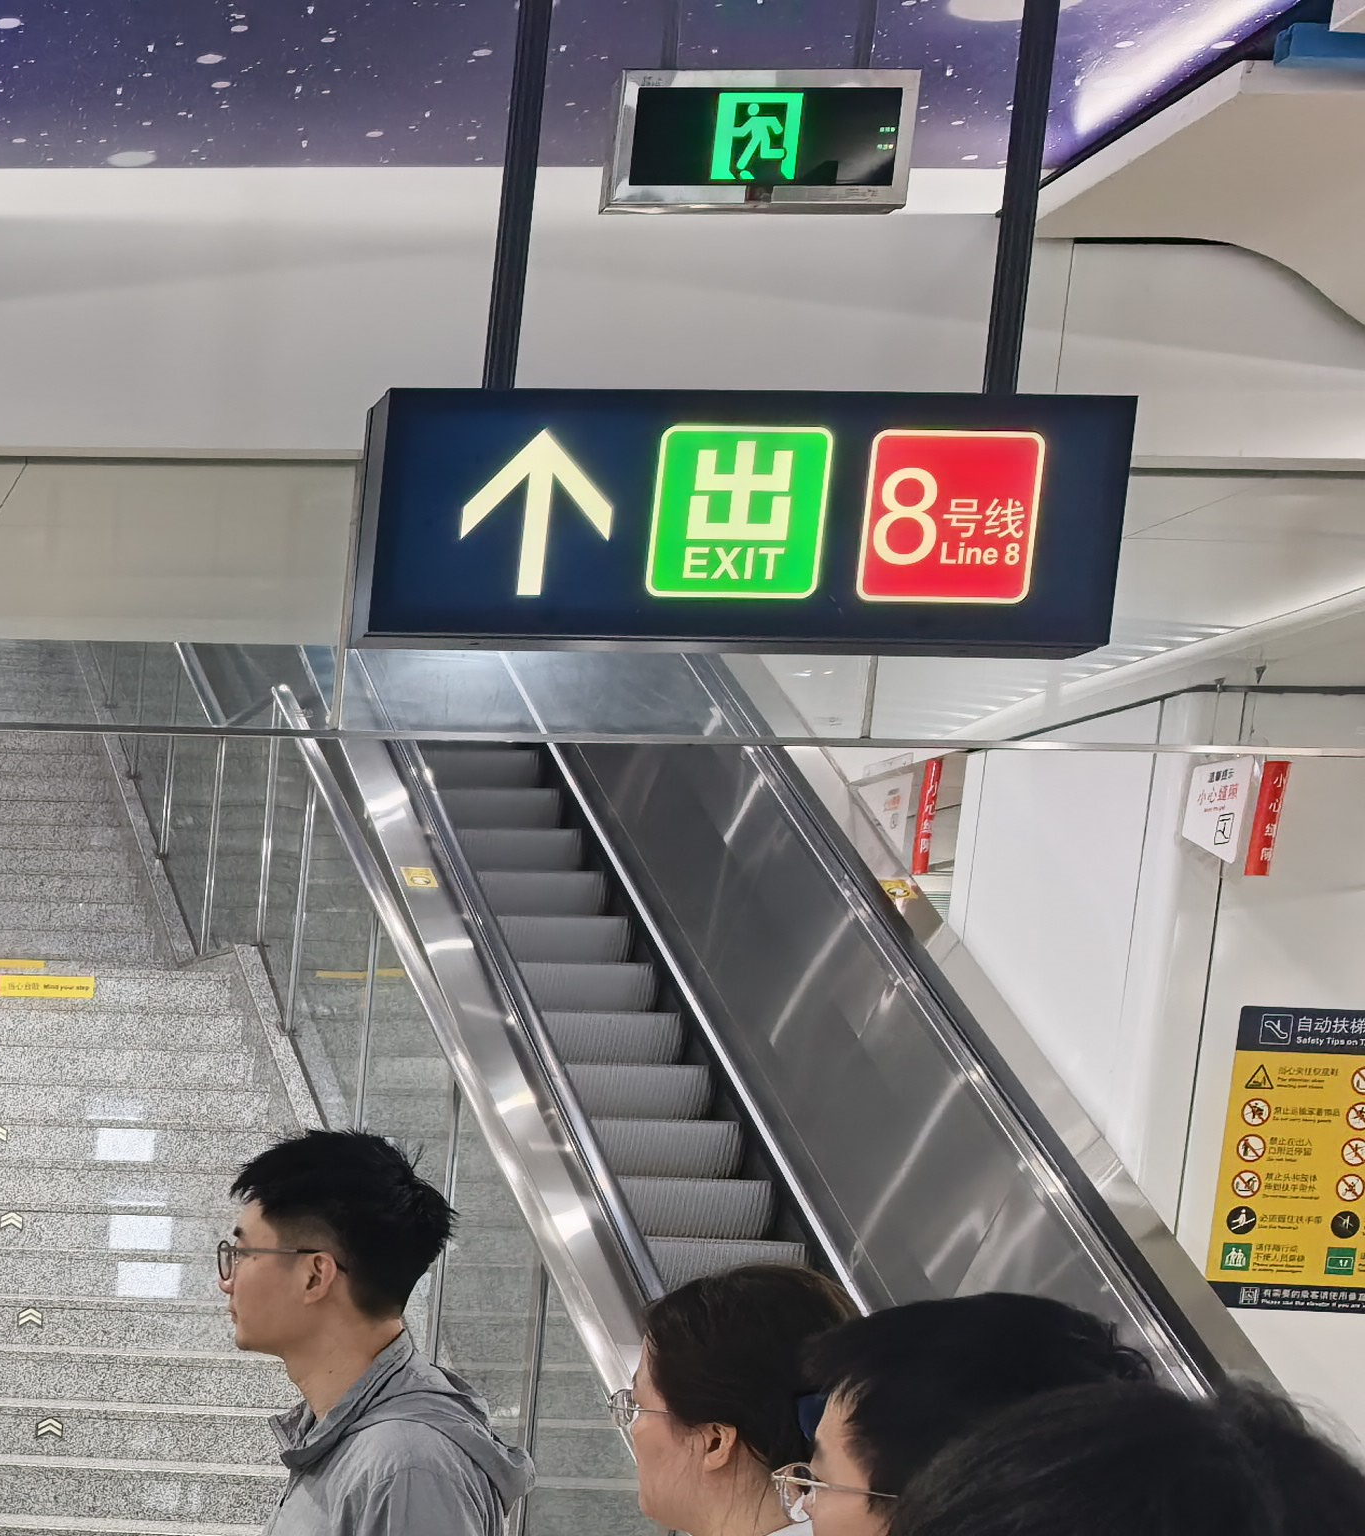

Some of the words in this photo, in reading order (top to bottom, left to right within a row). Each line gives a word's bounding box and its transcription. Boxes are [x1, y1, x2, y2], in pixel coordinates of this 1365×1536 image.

[686, 441, 793, 541] 出
[682, 547, 785, 581] EXIT
[940, 542, 1000, 566] Line
[1005, 543, 1021, 566] 8
[1296, 1036, 1325, 1046] Safety
[1326, 1037, 1345, 1046] Tips
